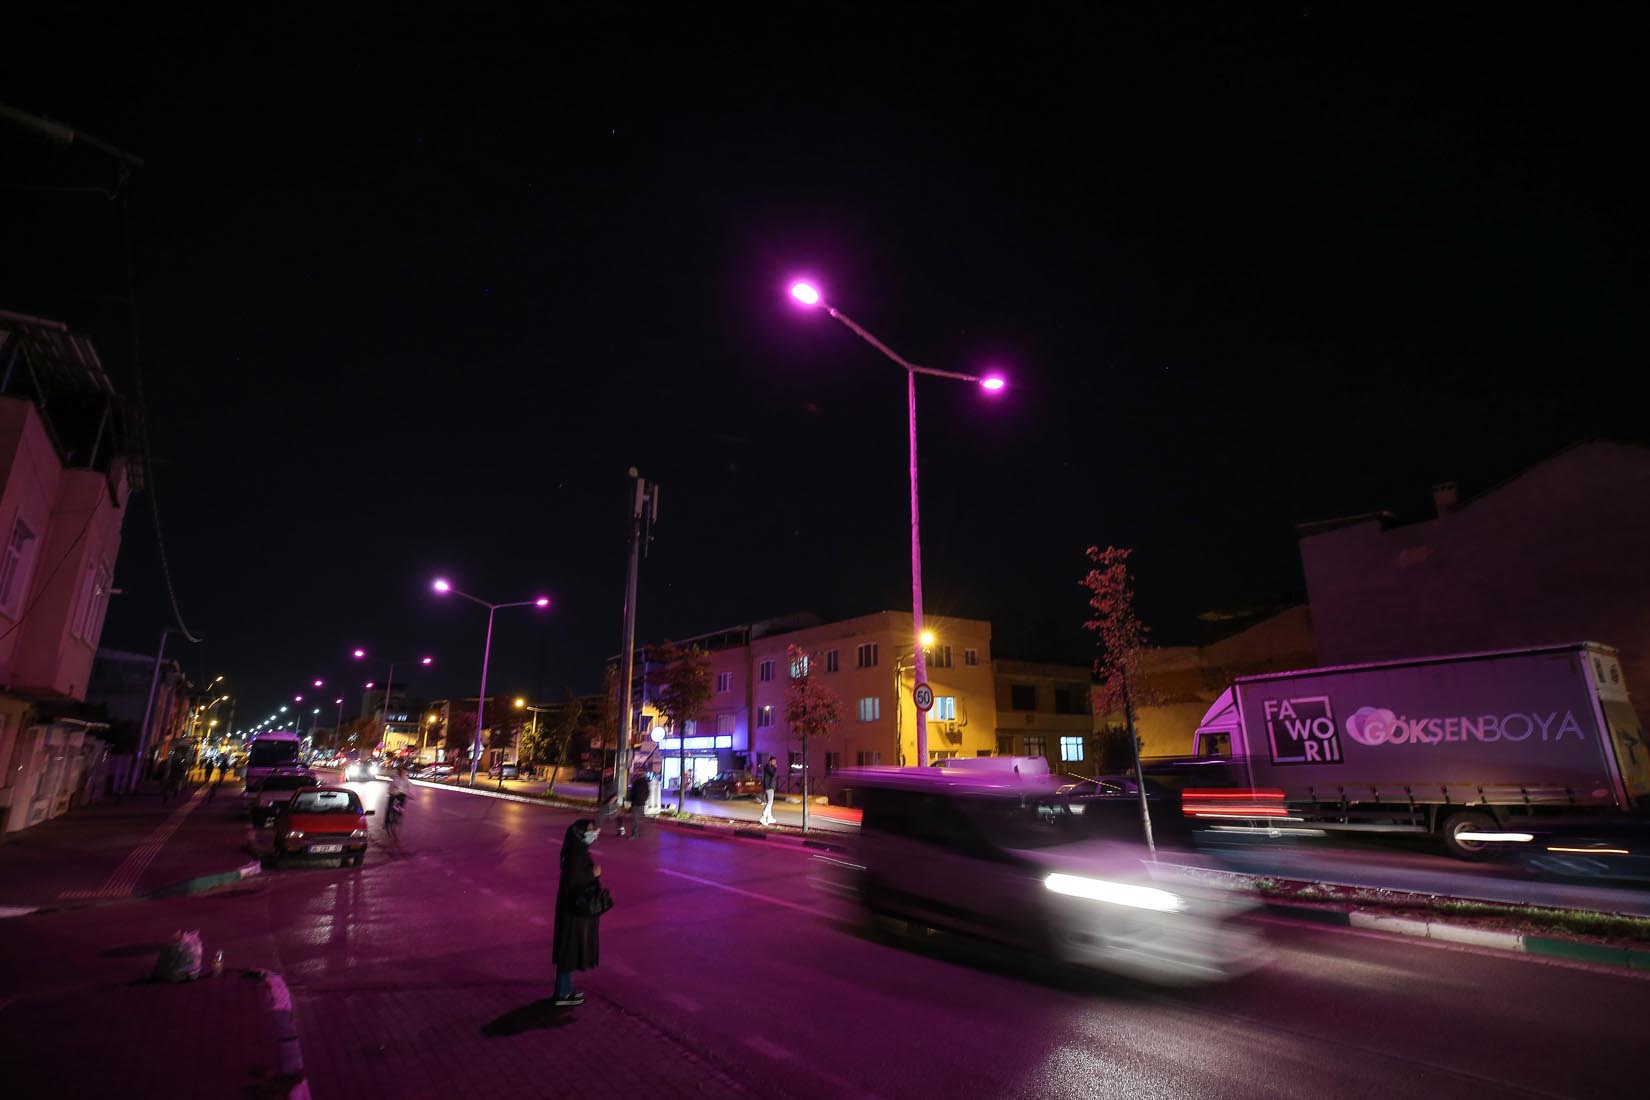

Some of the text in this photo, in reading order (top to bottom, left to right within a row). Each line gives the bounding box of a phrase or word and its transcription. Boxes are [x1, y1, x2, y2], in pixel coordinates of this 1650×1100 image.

[917, 690, 930, 704] 50
[1264, 700, 1297, 720] FA
[1284, 717, 1335, 741] WO
